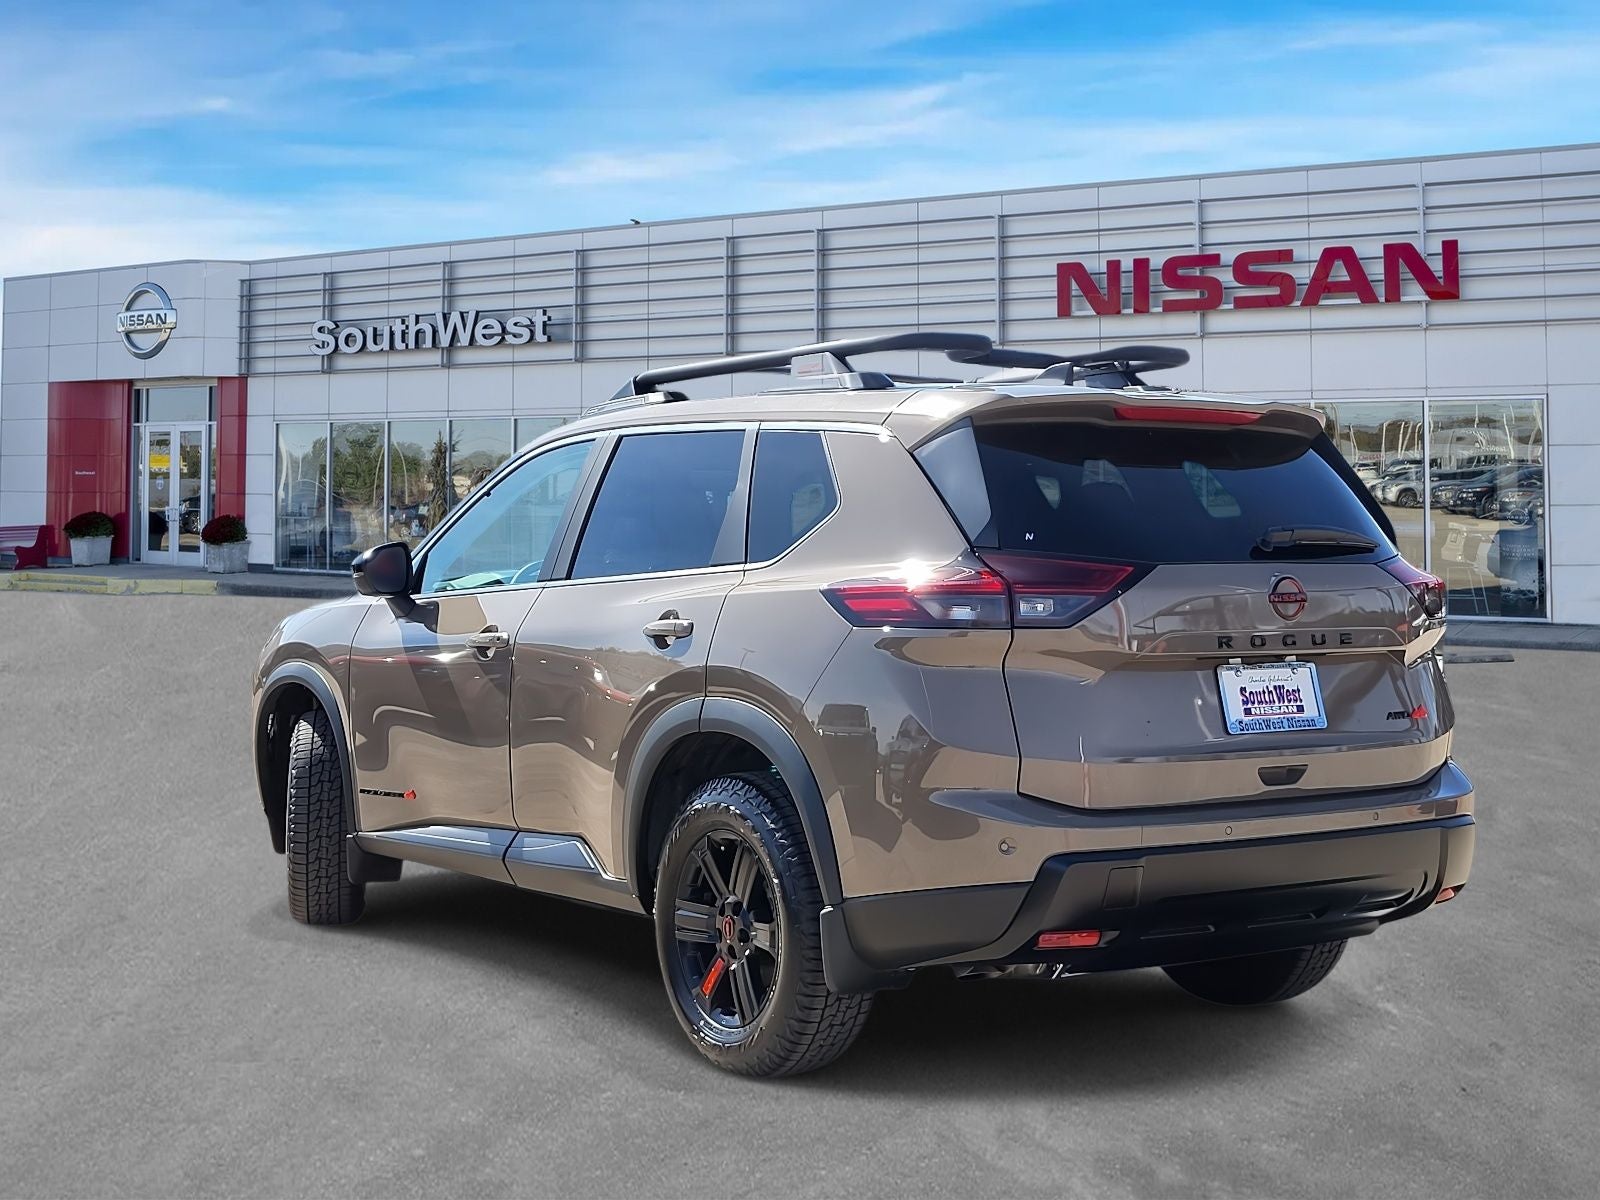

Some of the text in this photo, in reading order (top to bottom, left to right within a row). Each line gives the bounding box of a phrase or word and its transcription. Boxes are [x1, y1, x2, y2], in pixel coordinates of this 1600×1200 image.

[1056, 239, 1461, 318] NISSAN
[119, 312, 167, 328] NISSAN
[309, 308, 551, 356] SouthWest
[1217, 632, 1353, 650] ROGUE
[1239, 684, 1304, 707] SouthWest
[1250, 704, 1298, 716] NISSAN
[1238, 717, 1318, 732] SouthWest Nissan
